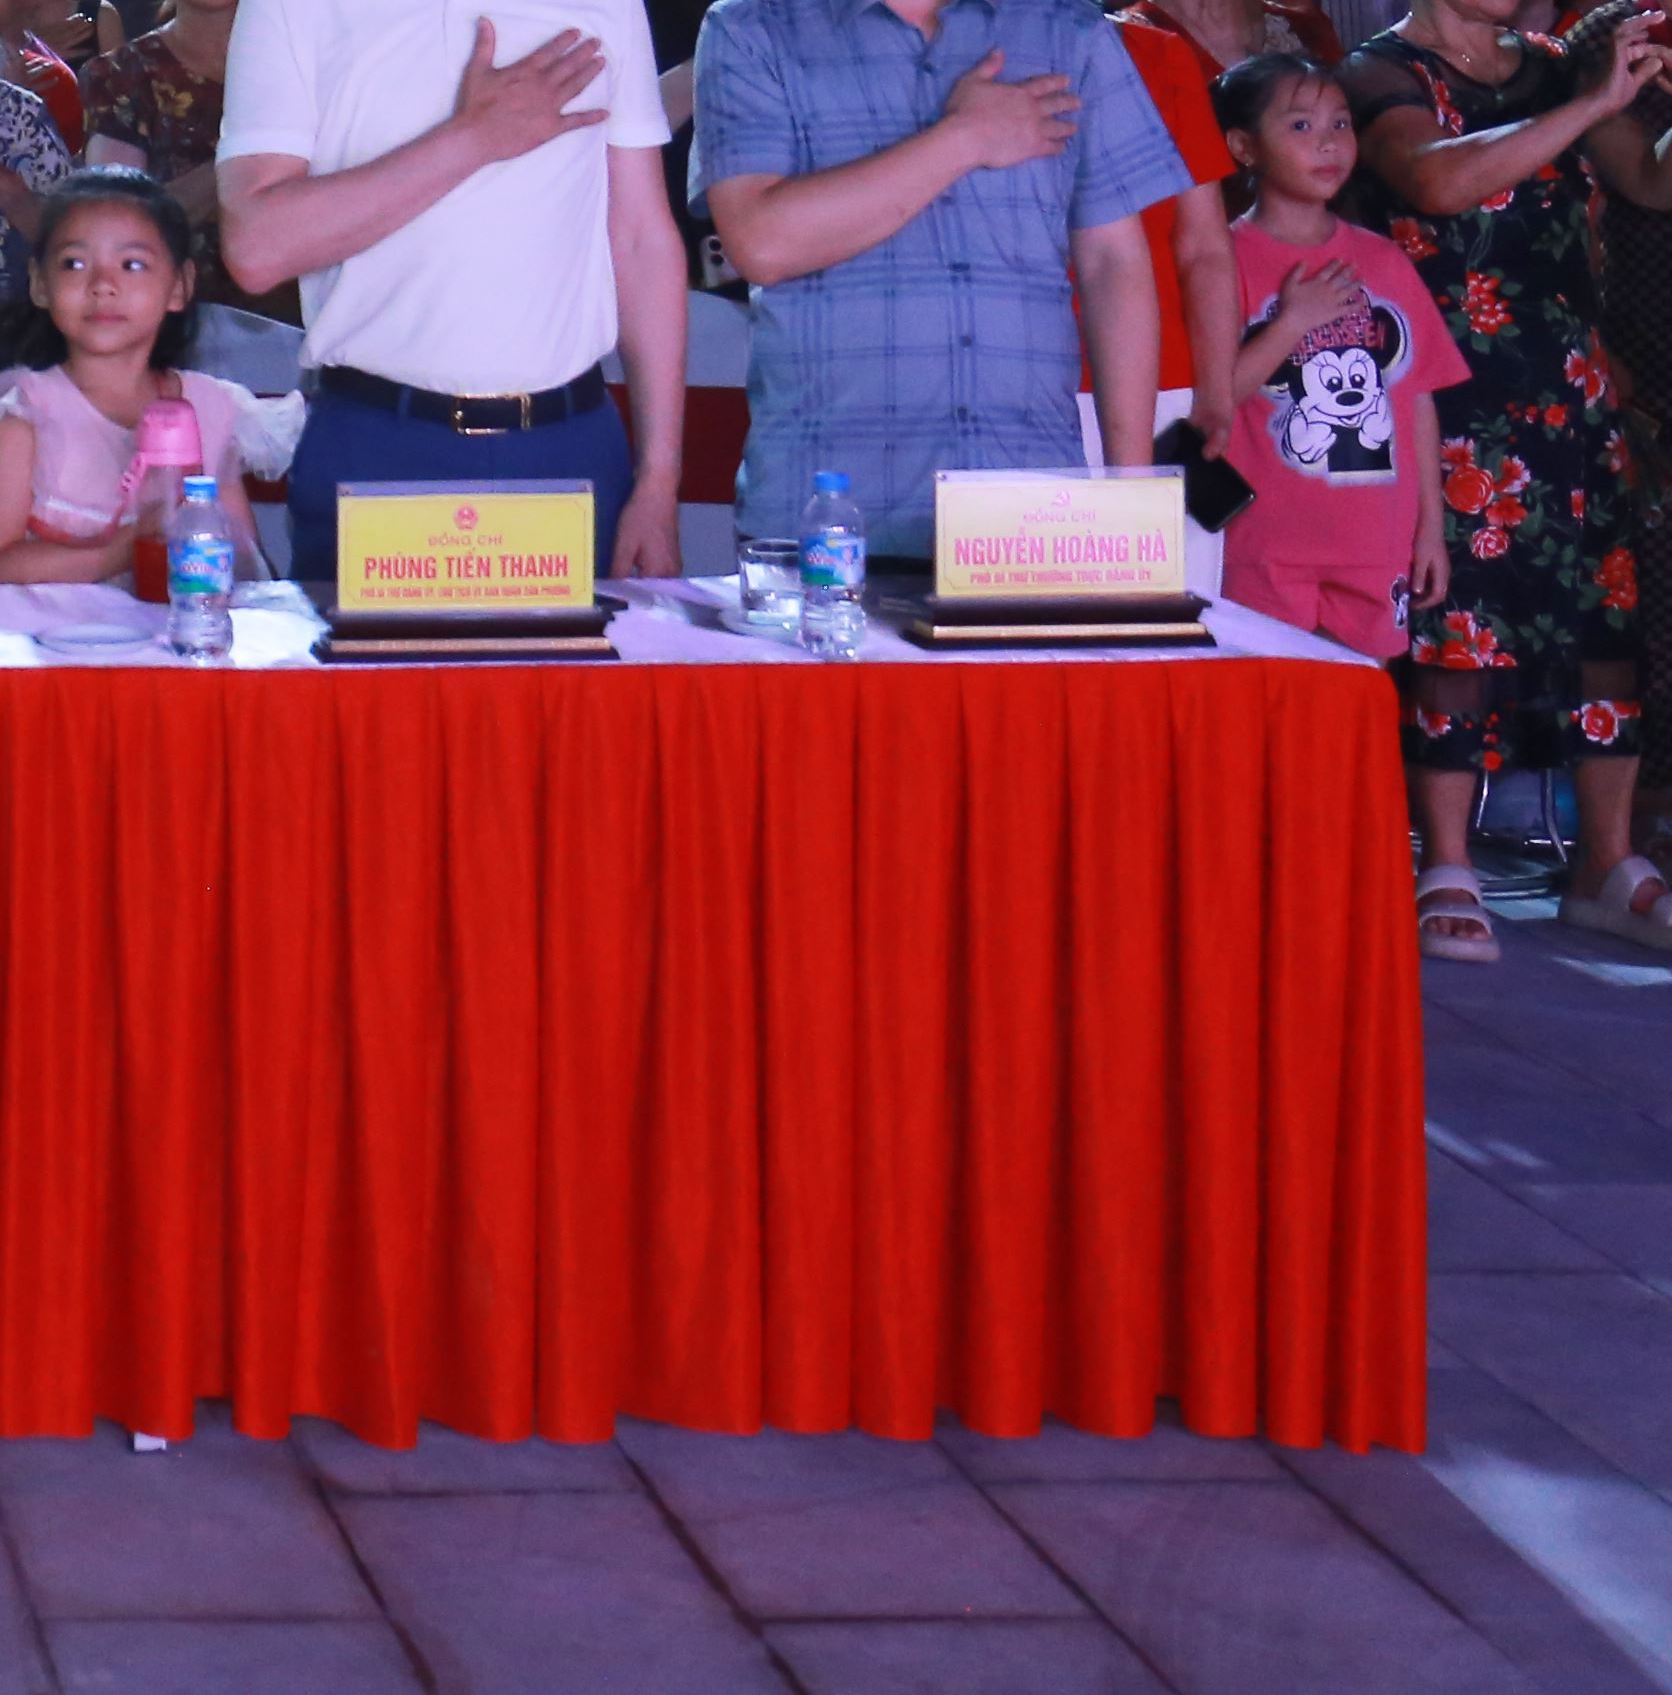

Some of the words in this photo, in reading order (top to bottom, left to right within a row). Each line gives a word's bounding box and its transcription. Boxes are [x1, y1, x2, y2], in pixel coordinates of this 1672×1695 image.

[428, 532, 471, 546] ĐỒNG
[477, 534, 503, 546] CHÍ
[954, 527, 1045, 565] NGUYỄN
[1053, 530, 1130, 564] HOÀNG
[1137, 529, 1167, 563] HÀ
[364, 551, 437, 580] PHÙNG
[446, 546, 492, 578] TIẾN
[500, 554, 568, 578] THANH
